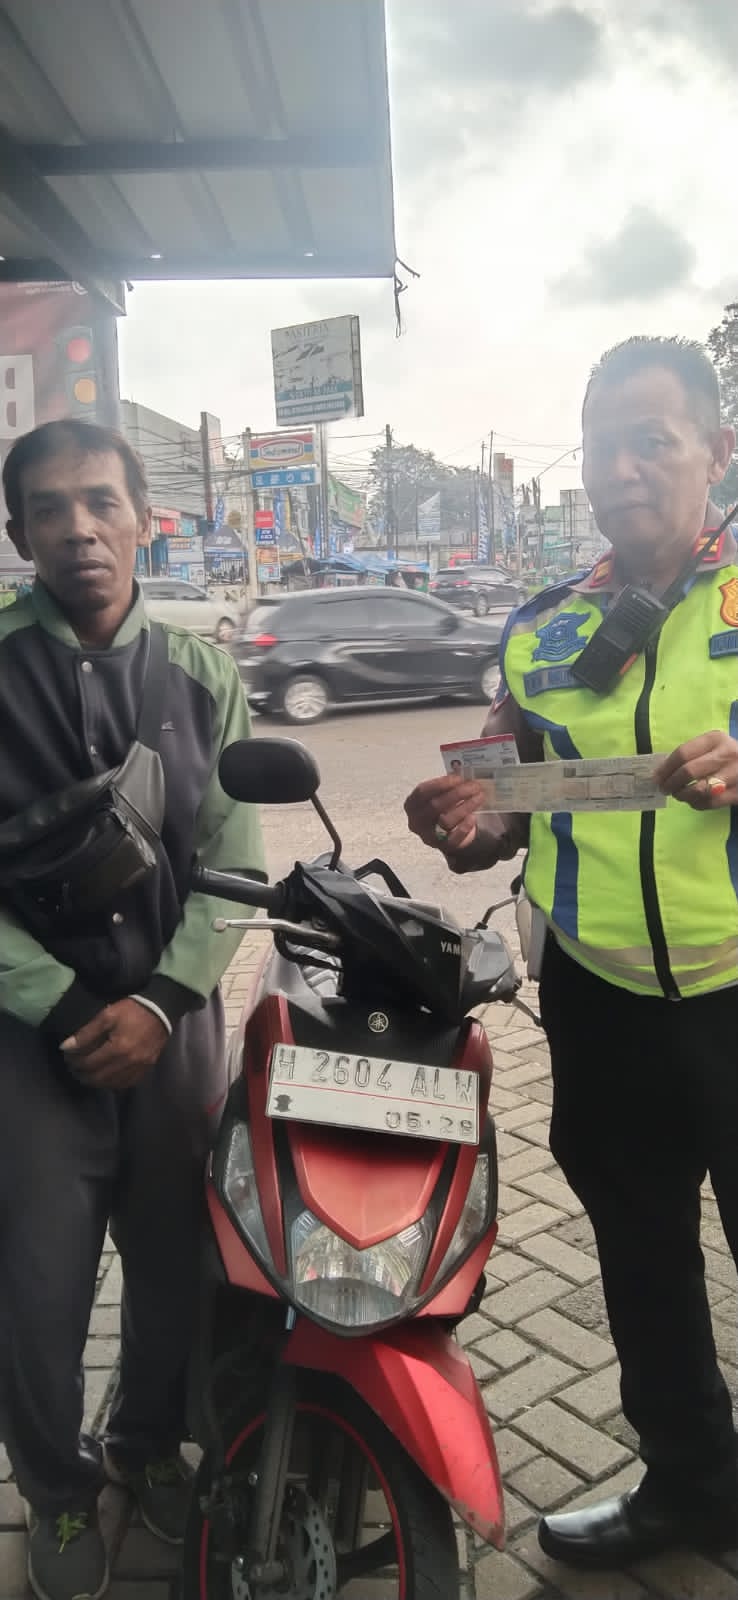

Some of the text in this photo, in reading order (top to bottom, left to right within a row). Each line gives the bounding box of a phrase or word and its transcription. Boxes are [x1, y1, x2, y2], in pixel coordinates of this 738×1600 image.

[278, 1046, 474, 1103] H 2604 ALW
